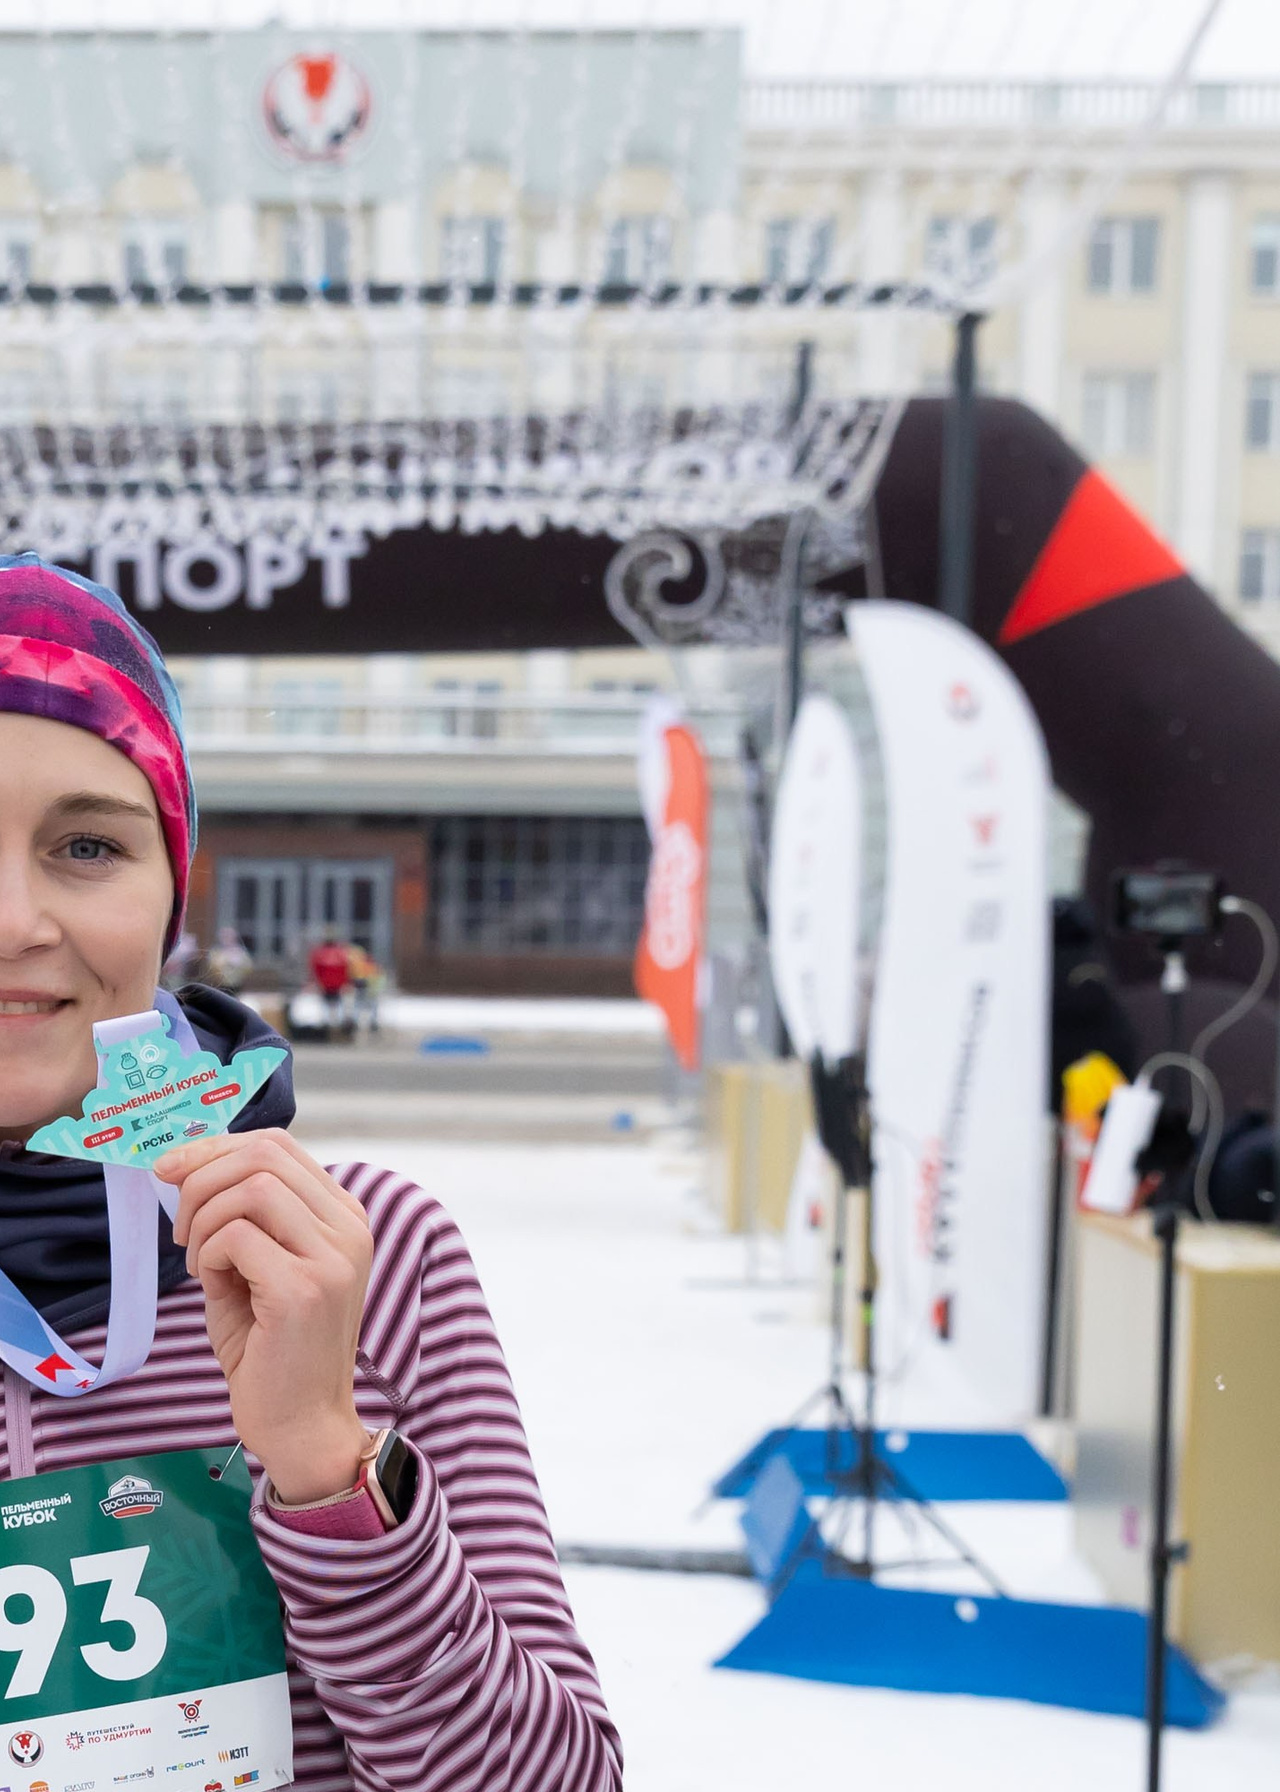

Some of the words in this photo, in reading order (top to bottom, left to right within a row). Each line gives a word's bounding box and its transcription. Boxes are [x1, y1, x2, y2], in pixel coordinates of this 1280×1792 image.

[50, 532, 370, 612] ПОРТ
[90, 1083, 175, 1123] ПЕЛЬМЕННЫЙ
[176, 1069, 219, 1092] КУБОК
[144, 1100, 192, 1121] КАЛАШНИКОВ
[146, 1115, 169, 1127] СПОРТ
[142, 1131, 175, 1151] РСХБ
[0, 1493, 72, 1516] ПЕЛЬМЕННЫЙ
[103, 1492, 162, 1512] ВОСТОЧНЫЙ
[2, 1508, 58, 1530] КУБОК
[86, 1723, 135, 1736] ПУТЕШЕСТВУЙ
[88, 1736, 101, 1744] ПО
[103, 1727, 152, 1742] УДМУРТИИ
